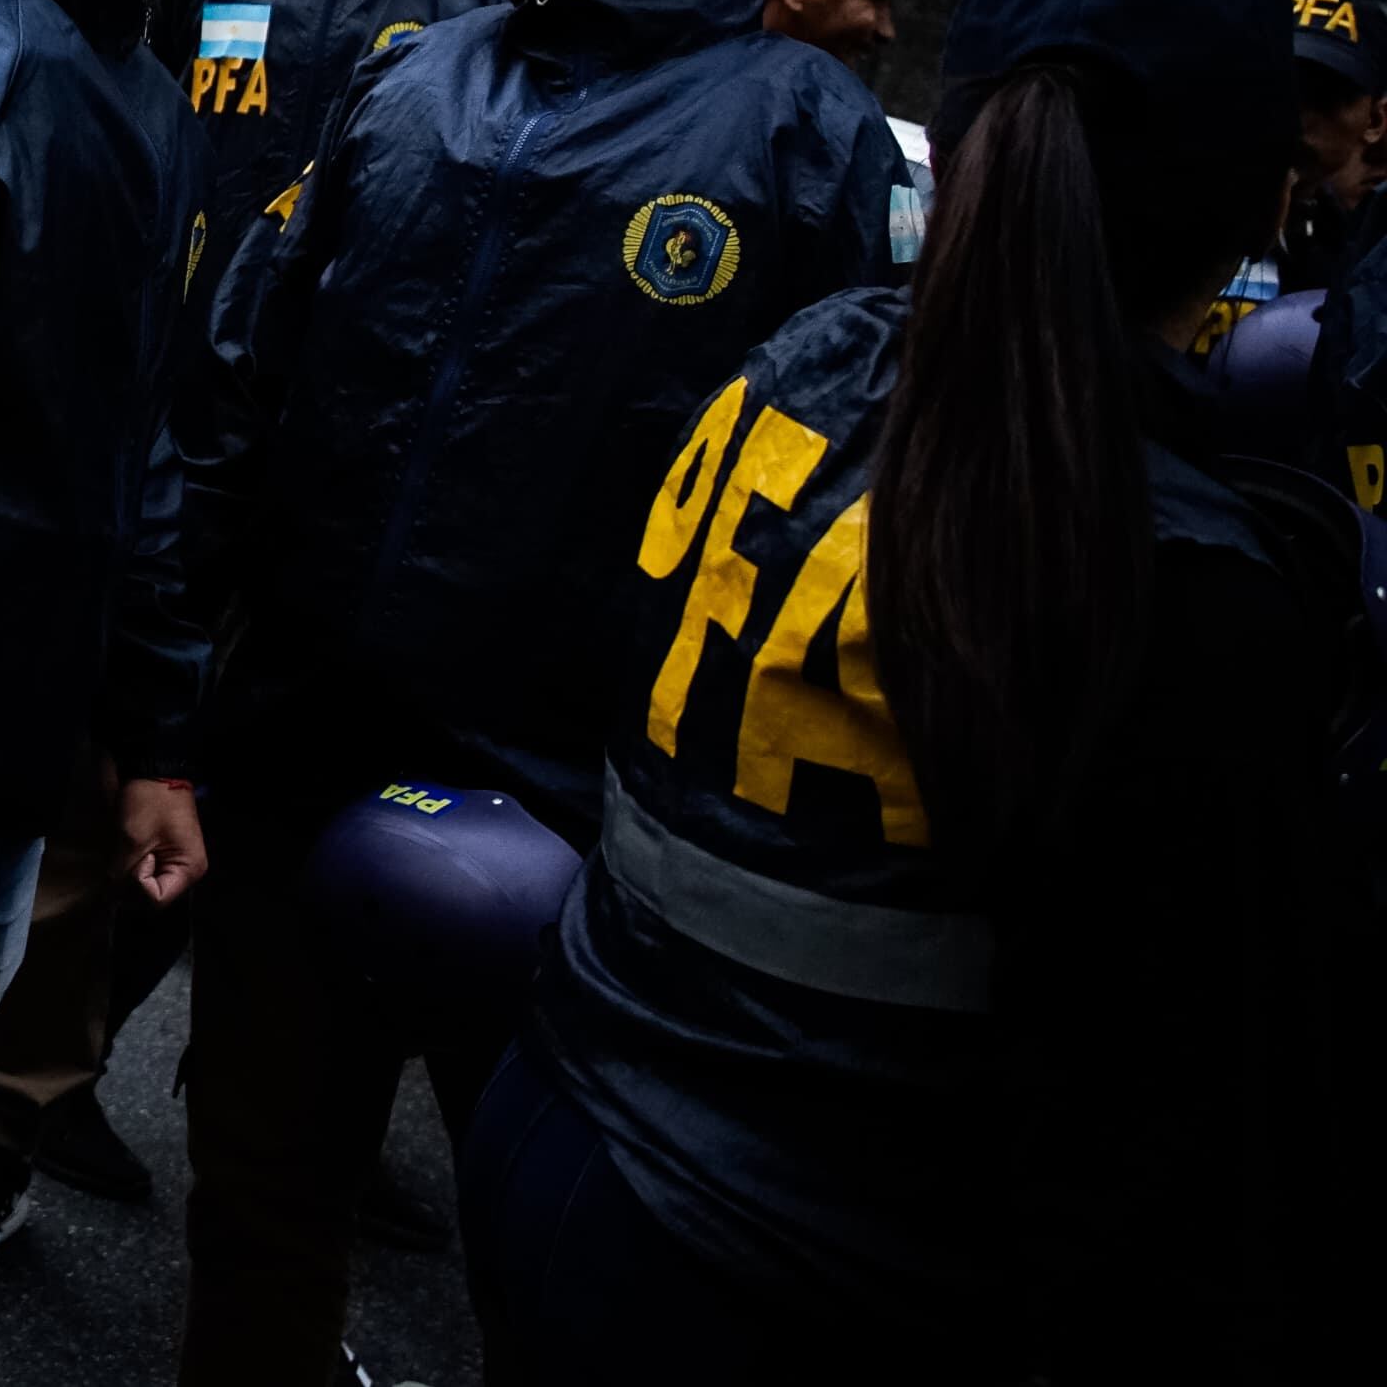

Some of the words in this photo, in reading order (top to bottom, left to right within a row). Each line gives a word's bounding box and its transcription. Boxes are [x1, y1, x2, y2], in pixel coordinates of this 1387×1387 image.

[191, 57, 269, 117] PFA
[636, 375, 932, 849] PFA
[378, 783, 453, 815] PFA
